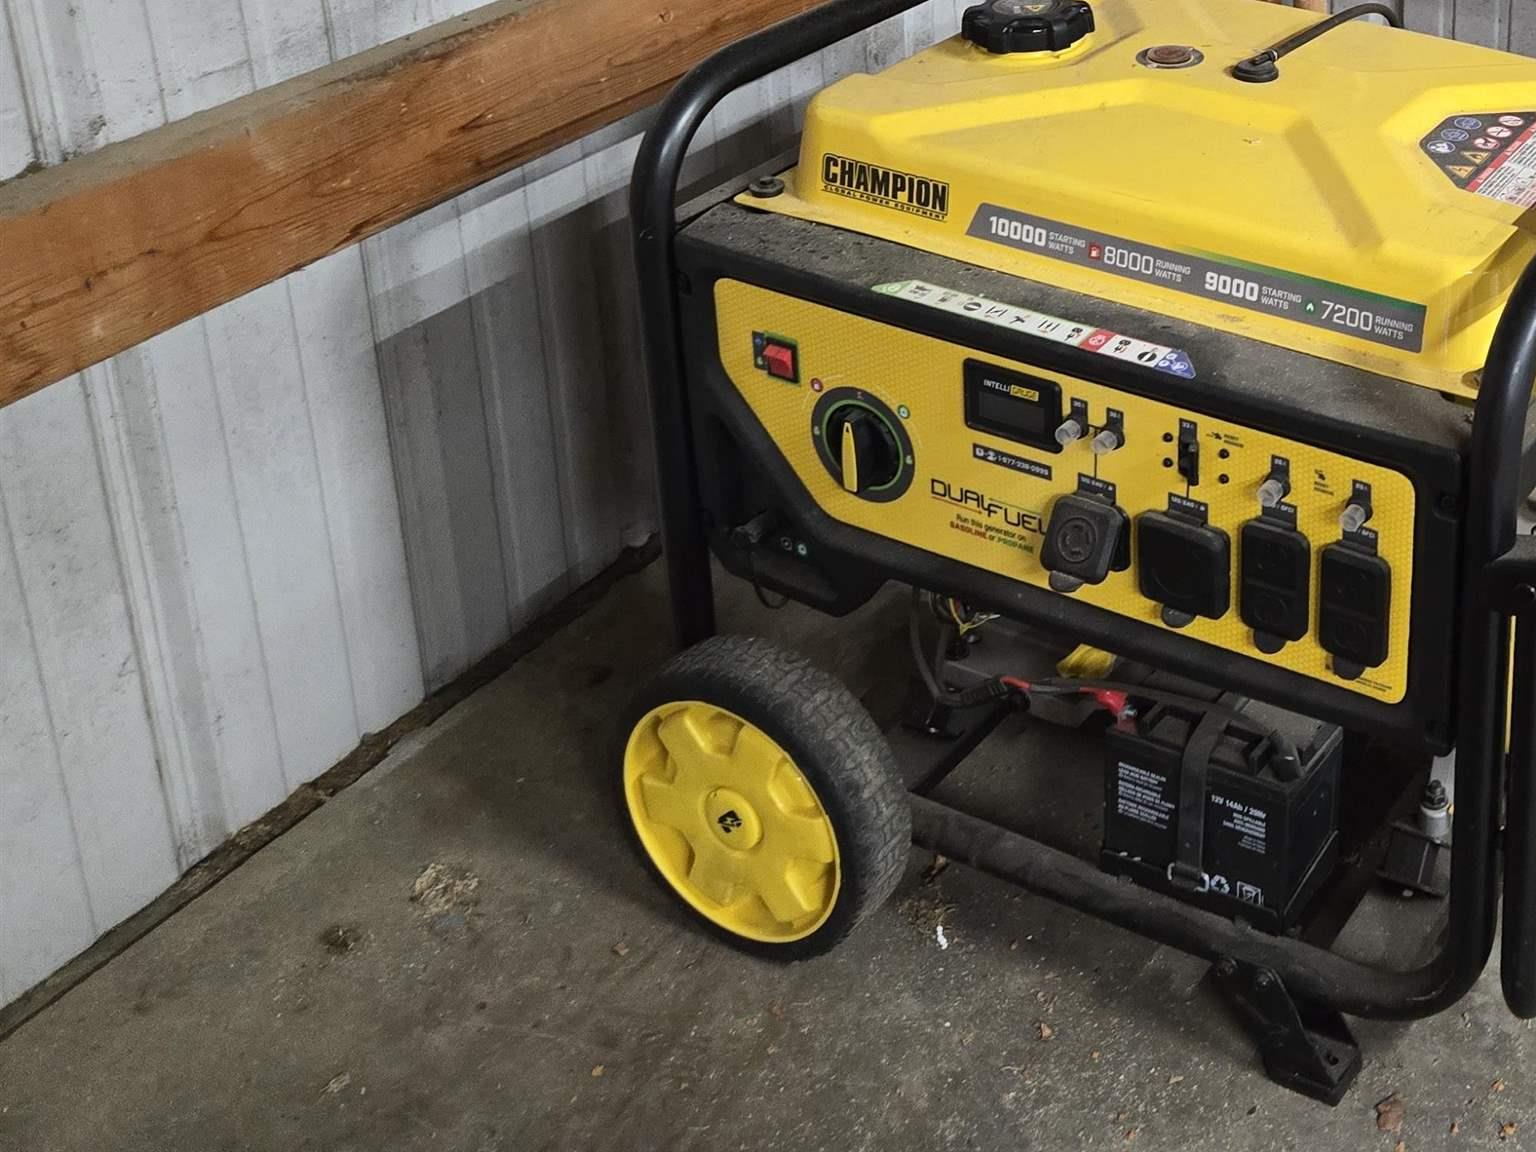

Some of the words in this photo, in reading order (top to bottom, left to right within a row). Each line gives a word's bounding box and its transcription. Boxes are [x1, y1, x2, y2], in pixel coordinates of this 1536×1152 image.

[823, 154, 948, 213] CHAMPION
[988, 215, 1047, 247] 10000
[1049, 232, 1086, 248] STARTING
[1048, 242, 1075, 255] WATTS
[1103, 246, 1153, 274] 8000
[1155, 259, 1191, 275] RUNNING
[1154, 269, 1182, 283] WATTS
[1204, 272, 1258, 302] 9000
[1261, 286, 1302, 303] STARTING
[1260, 296, 1289, 310] WATTS
[1322, 300, 1373, 331] 7200
[1375, 315, 1414, 332] RUNNING
[1374, 325, 1404, 340] WATTS
